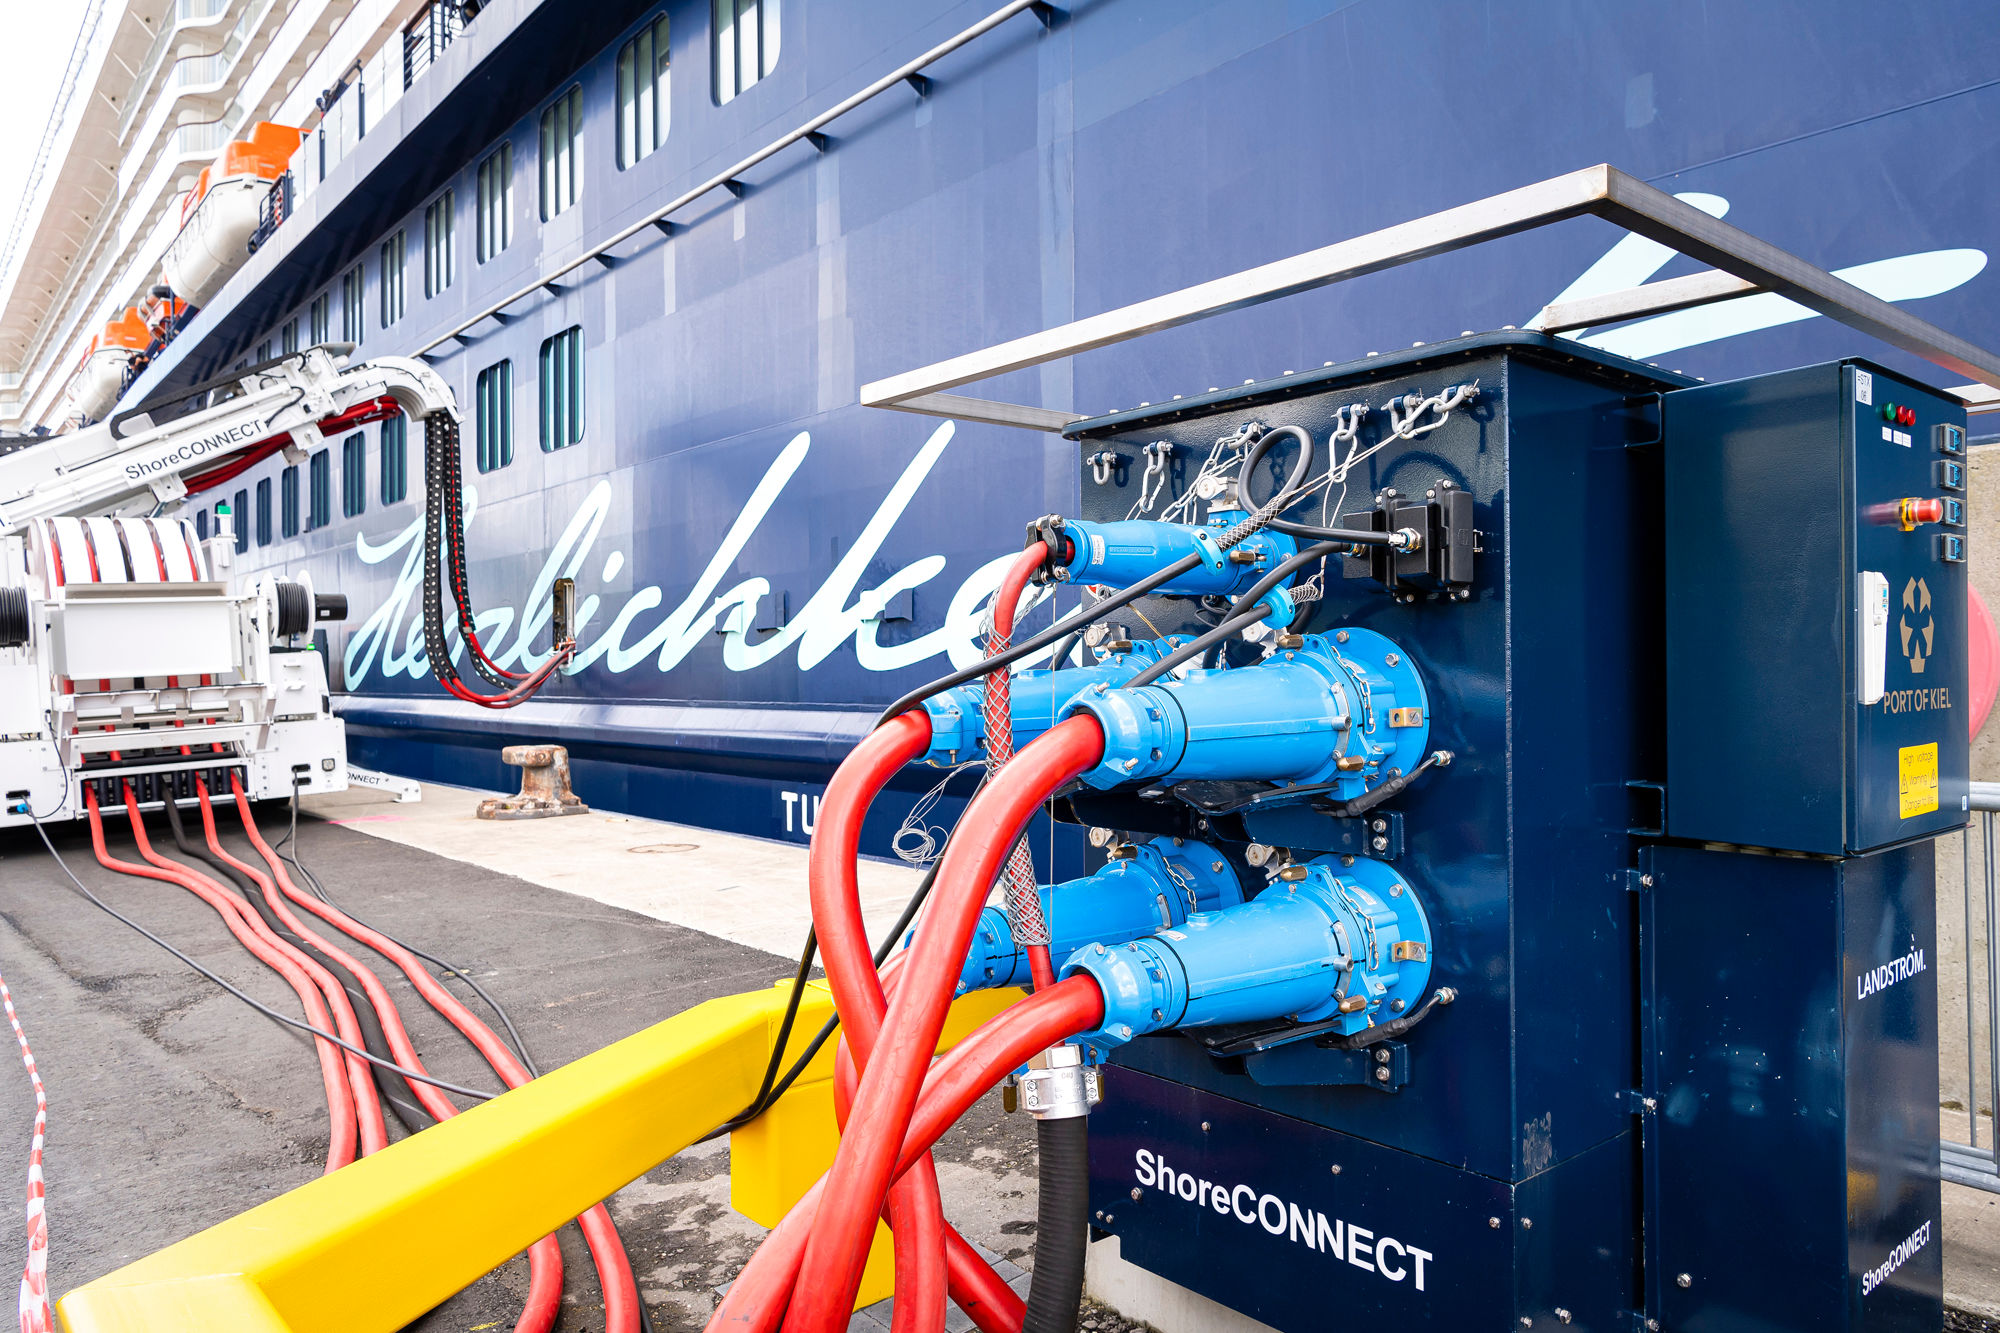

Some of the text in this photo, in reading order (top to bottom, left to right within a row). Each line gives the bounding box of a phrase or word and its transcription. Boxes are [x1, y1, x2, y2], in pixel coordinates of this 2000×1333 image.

[125, 419, 263, 480] ShoreCONNECT
[1883, 687, 1952, 714] PORT OF KIEL
[781, 791, 819, 835] TU
[1135, 1148, 1433, 1292] ShoreCONNECT
[1862, 1219, 1931, 1296] ShoreCONNECT
